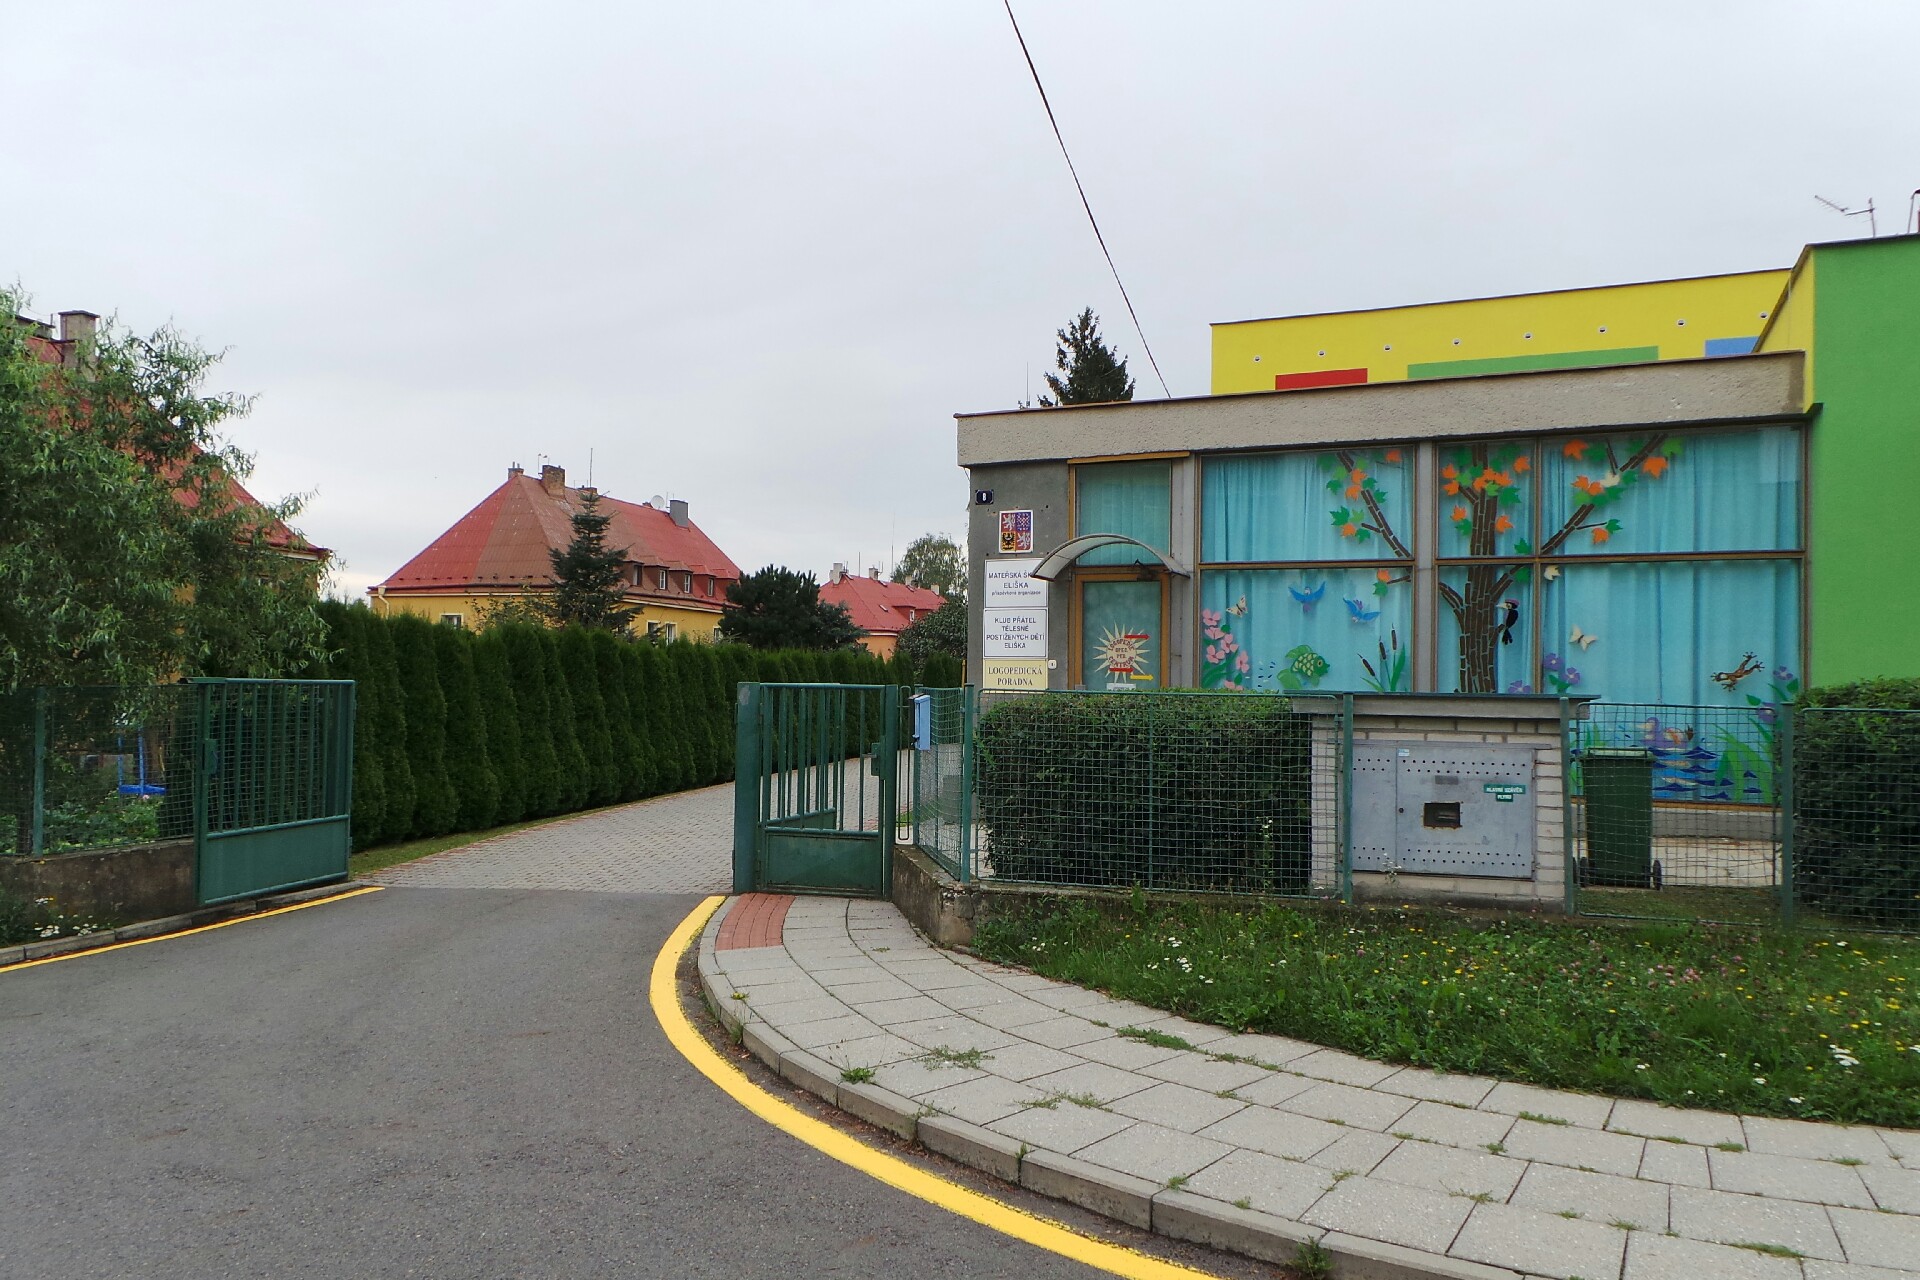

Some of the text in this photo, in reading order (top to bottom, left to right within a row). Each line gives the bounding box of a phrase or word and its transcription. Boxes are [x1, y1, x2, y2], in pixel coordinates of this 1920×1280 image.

[982, 492, 987, 502] 8
[1003, 580, 1029, 589] ELIŠKA
[1012, 615, 1037, 624] PŘÁTEL
[1004, 641, 1026, 649] ELIŠKA
[988, 665, 1043, 675] LOGOPEDICKÁ
[997, 677, 1033, 686] PORADNA
